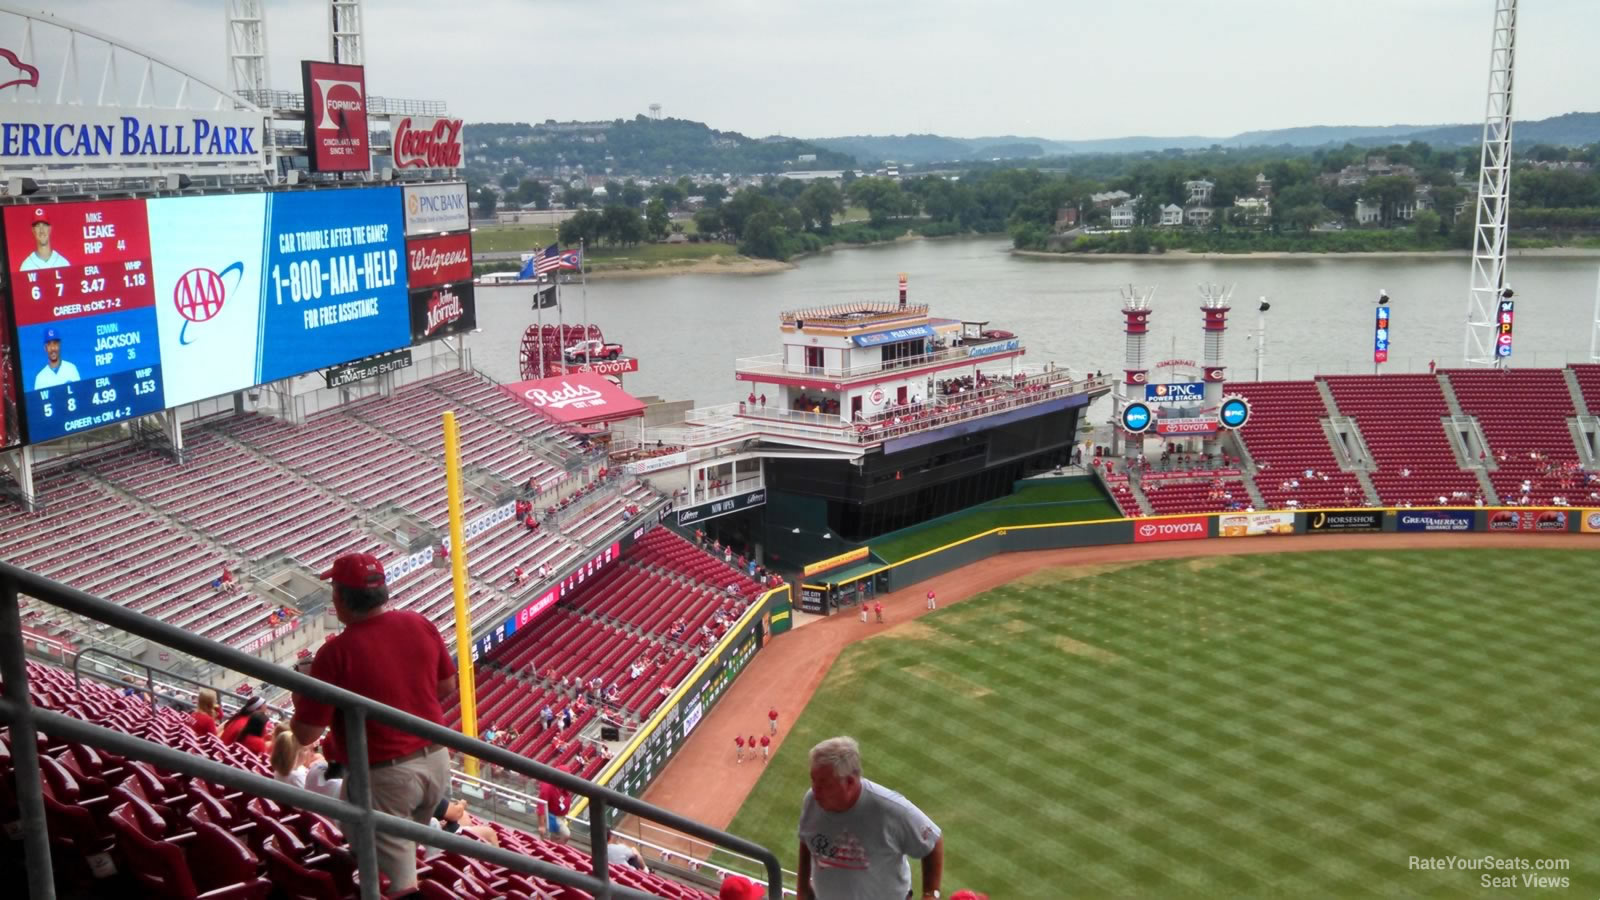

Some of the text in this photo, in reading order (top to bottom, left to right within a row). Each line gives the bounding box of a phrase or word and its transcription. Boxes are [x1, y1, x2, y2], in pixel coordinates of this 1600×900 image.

[327, 100, 361, 111] FORMICA
[120, 116, 190, 155] BALL
[193, 118, 259, 154] PARK
[394, 117, 464, 168] Coca-Cola
[420, 194, 464, 212] PNC BANK
[86, 212, 102, 222] MIKE
[83, 224, 115, 240] LEAKE
[279, 224, 388, 254] CAR TROUBLE AFTER THE GAME?
[84, 240, 126, 254] RHP 44
[28, 260, 142, 282] W L ERA WHIP
[410, 248, 468, 275] Walgreens
[31, 273, 146, 300] 6 7 3.47 1.18
[272, 249, 398, 305] 1-800-AAA-HELP
[179, 269, 220, 320] AAA
[437, 290, 453, 306] John
[53, 304, 81, 316] CAREER
[91, 301, 106, 310] CHC
[304, 297, 378, 330] FOR FREE ASSISTANCE
[96, 323, 118, 336] EDWIN
[94, 331, 140, 352] JACKSON
[95, 352, 114, 366] RHP
[594, 362, 632, 374] TOYOTA
[331, 358, 410, 386] ULTIMATE AIR SHUTTLE
[40, 368, 152, 400] W L ERA WHIP
[525, 381, 601, 407] Reds
[1168, 384, 1196, 396] PNC
[44, 380, 156, 417] 5 8 4.99 1.53
[64, 416, 92, 432] CAREER
[102, 410, 114, 422] CIN
[712, 503, 722, 514] NOW
[722, 500, 734, 510] OPEN
[1158, 523, 1204, 534] TOYOTA
